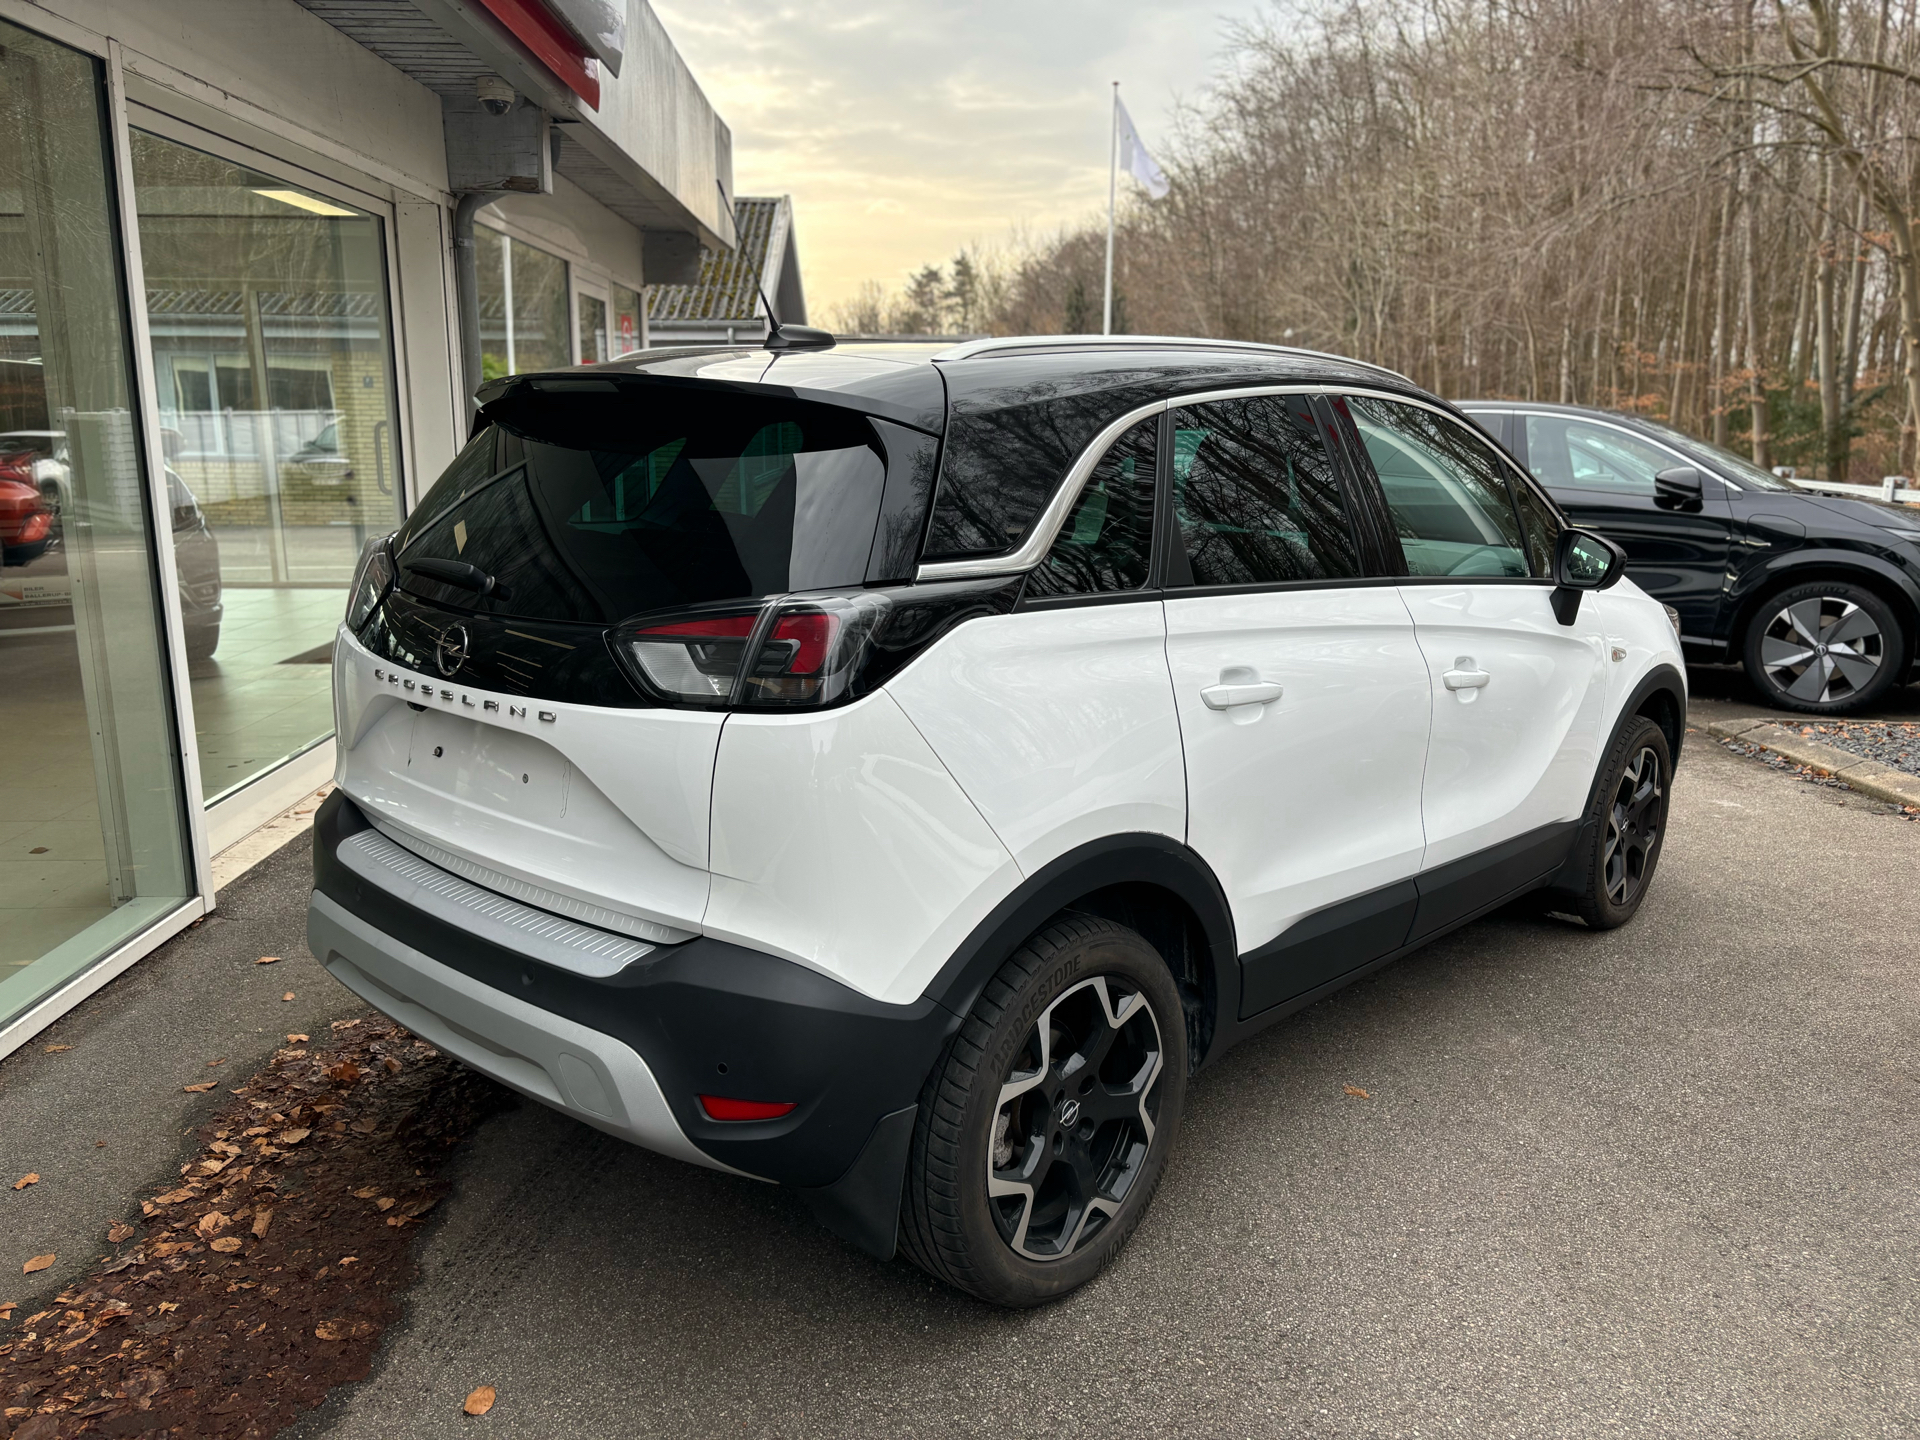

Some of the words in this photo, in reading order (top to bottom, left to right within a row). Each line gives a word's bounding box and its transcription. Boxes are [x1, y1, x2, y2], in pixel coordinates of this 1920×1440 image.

[1792, 585, 1846, 597] MICHELIN
[374, 669, 557, 723] CROSSLAND
[990, 954, 1081, 1077] BRIDGESTONE
